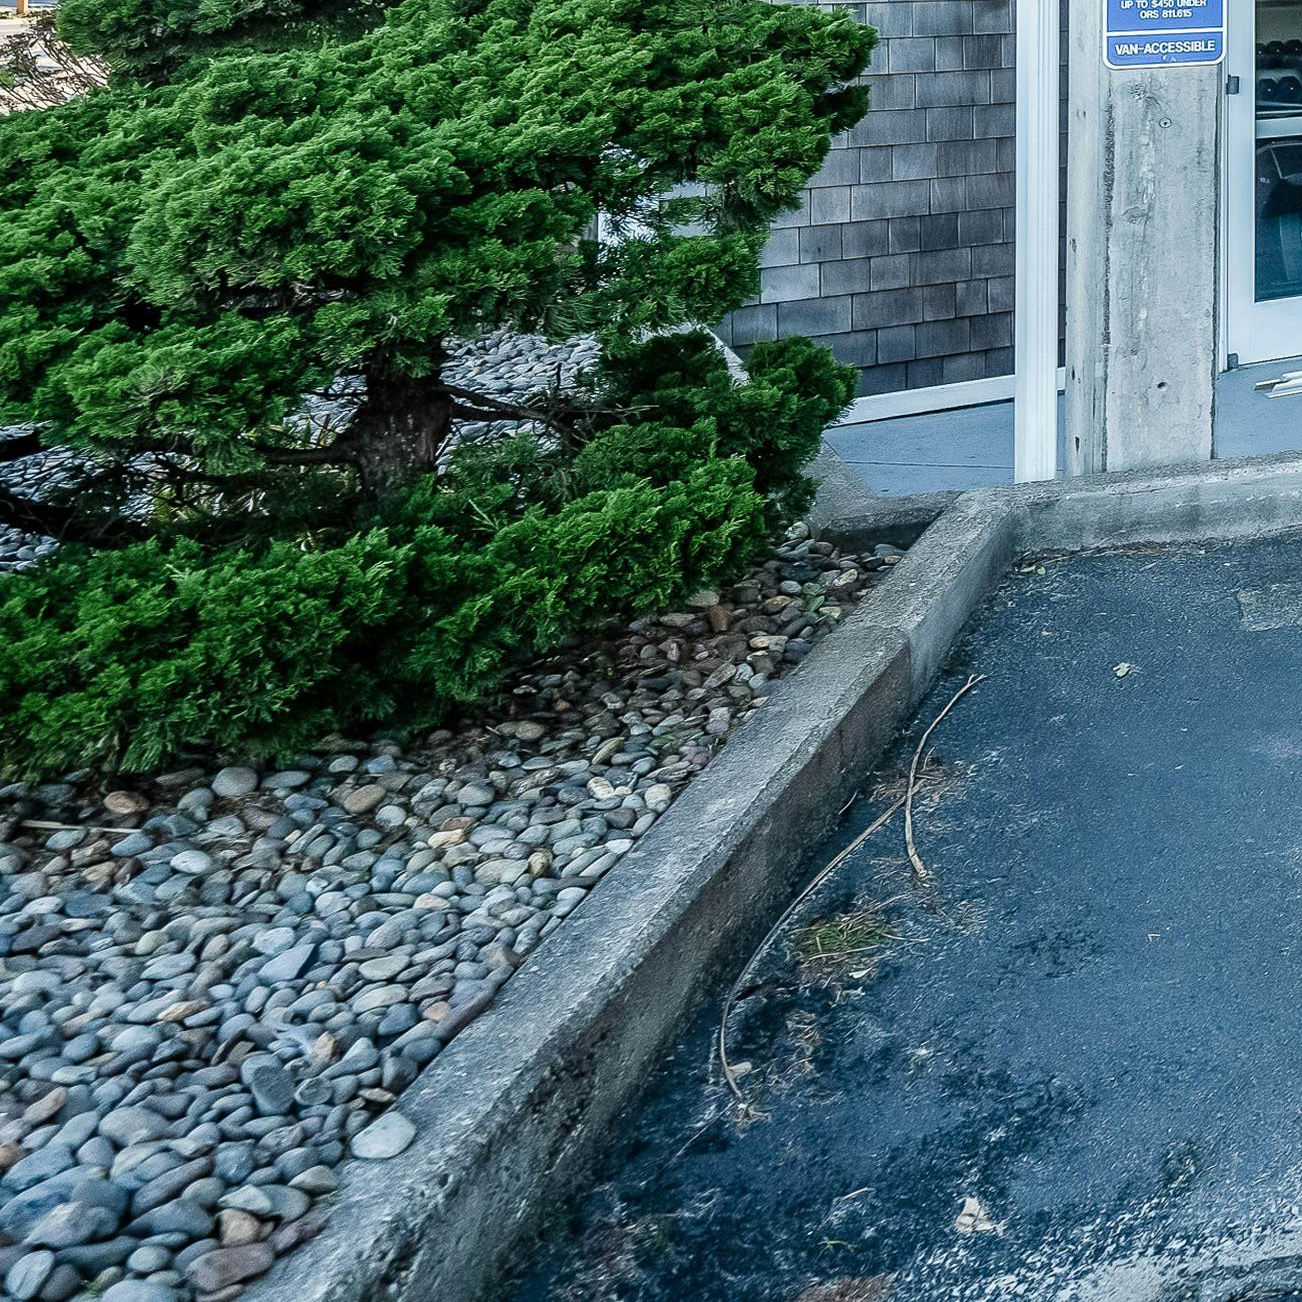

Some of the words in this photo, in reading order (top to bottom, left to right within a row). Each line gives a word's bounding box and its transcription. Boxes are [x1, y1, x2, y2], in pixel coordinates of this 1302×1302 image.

[1120, 0, 1133, 9] UP
[1135, 0, 1148, 8] TO
[1151, 0, 1174, 8] $450
[1140, 10, 1159, 19] ORS
[1115, 40, 1215, 55] VAN-ACCESSIBLE
